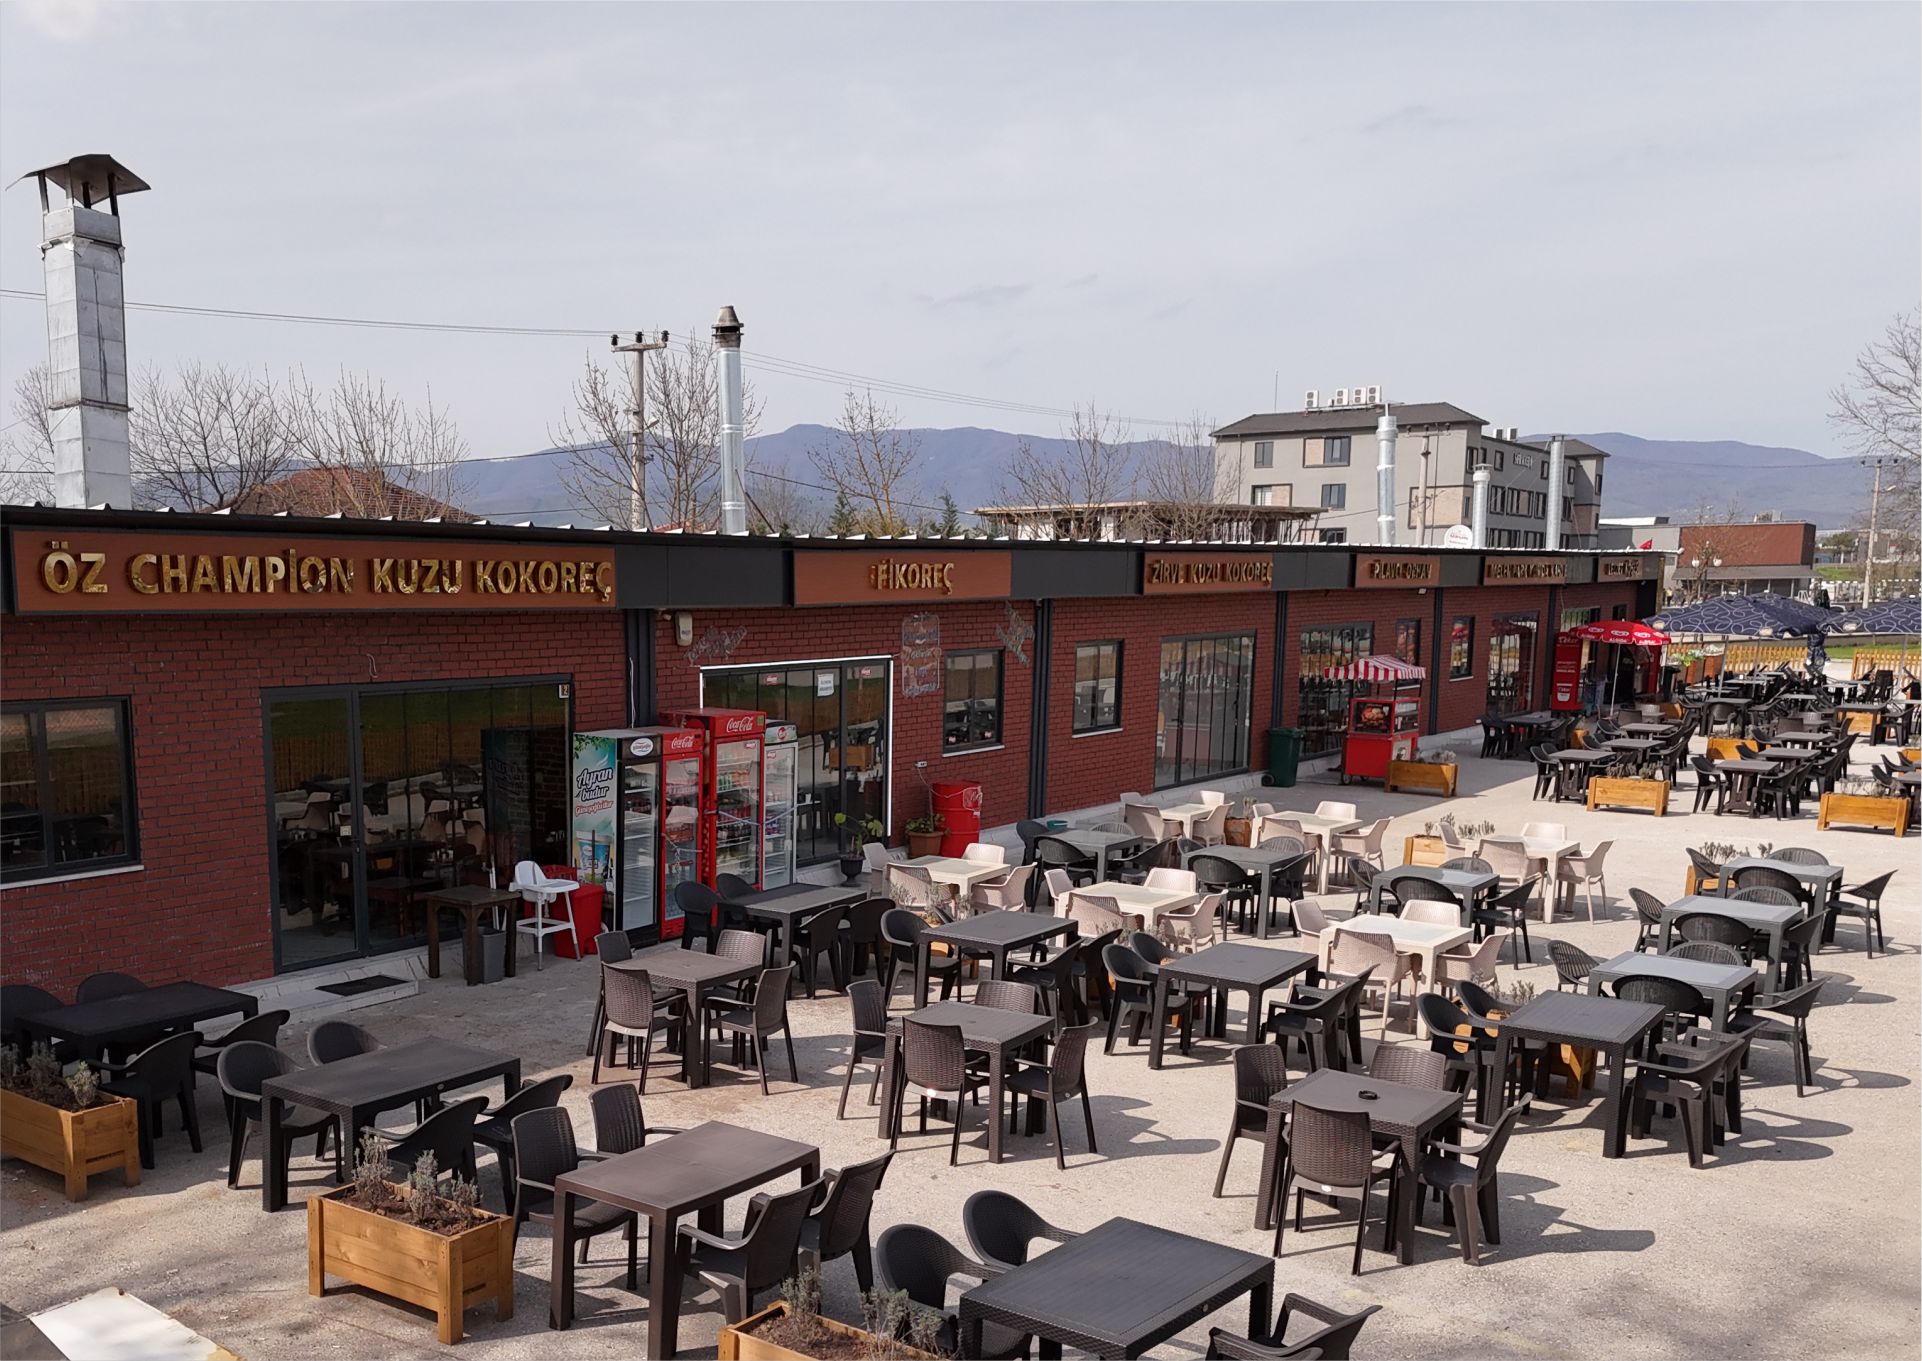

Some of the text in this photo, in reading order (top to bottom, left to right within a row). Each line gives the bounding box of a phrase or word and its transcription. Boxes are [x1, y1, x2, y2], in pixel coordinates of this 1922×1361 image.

[43, 540, 612, 603] ÖZ CHAMPİON KUZU KOKOREÇ
[1191, 562, 1221, 584] KUZU
[576, 768, 613, 789] Ayran
[581, 785, 609, 802] budur
